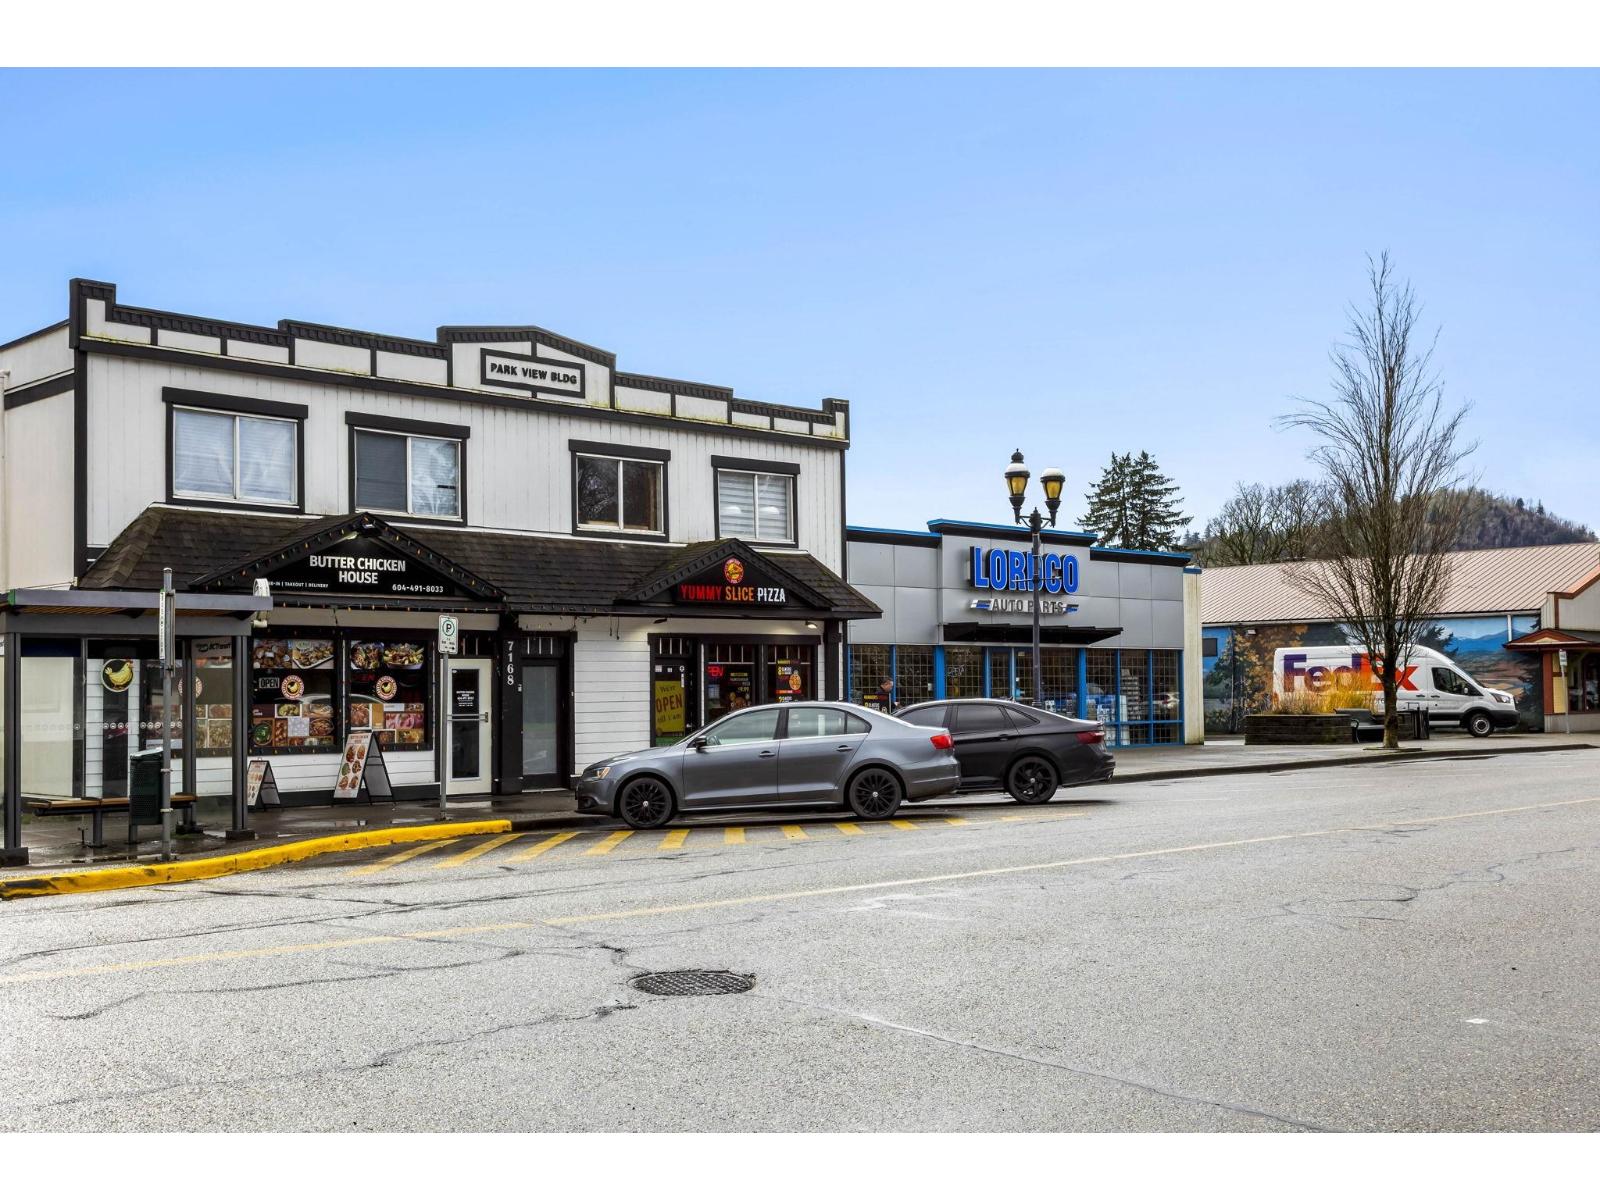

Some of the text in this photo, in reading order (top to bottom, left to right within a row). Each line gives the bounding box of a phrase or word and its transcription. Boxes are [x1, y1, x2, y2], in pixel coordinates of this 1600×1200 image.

[490, 363, 577, 384] PARK VIEW BLDG
[309, 555, 406, 572] BUTTER CHICKEN
[971, 546, 1079, 594] LORDCO
[338, 570, 379, 584] HOUSE
[392, 584, 444, 593] 604-491-8033
[681, 585, 786, 602] YUMMY SLICE PIZZA
[993, 599, 1064, 615] AUTO PRTS
[1283, 653, 1419, 692] FedEx
[656, 694, 682, 713] OPEN
